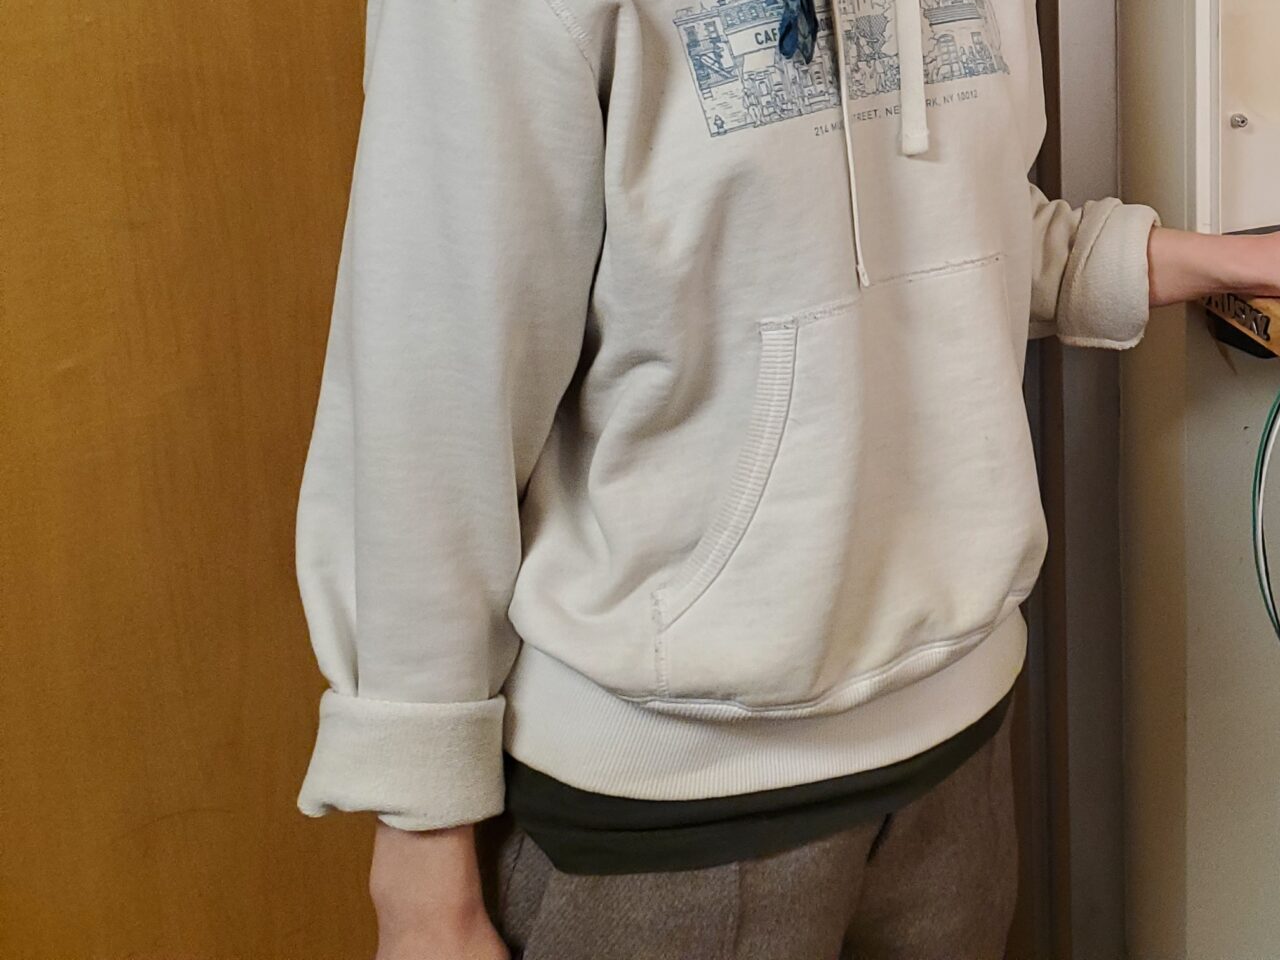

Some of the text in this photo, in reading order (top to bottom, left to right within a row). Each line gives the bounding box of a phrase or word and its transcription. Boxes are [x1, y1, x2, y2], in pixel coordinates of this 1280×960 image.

[754, 27, 779, 45] CAF
[885, 105, 901, 117] NE
[943, 94, 953, 105] NY
